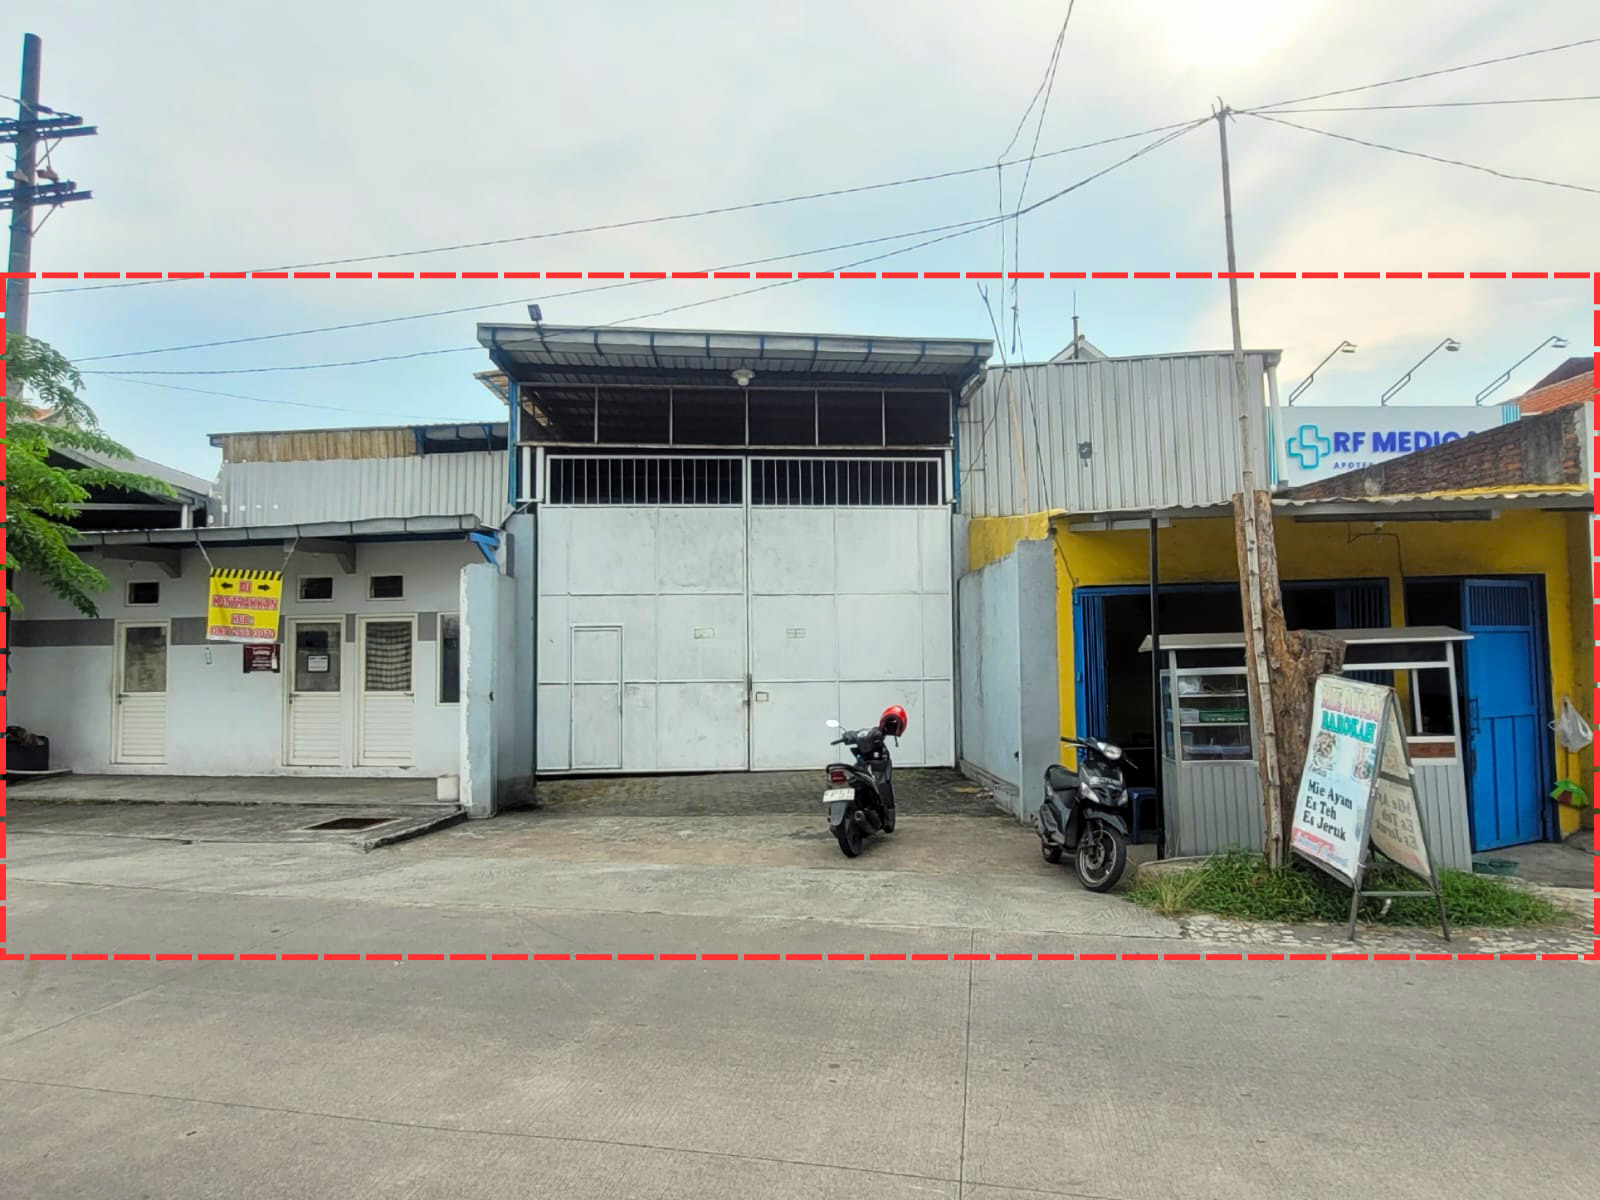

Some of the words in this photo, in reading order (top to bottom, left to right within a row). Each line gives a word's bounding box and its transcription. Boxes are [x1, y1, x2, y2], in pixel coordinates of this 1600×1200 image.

[1333, 431, 1366, 453] RF
[1372, 431, 1477, 453] MEDIC
[1305, 796, 1317, 811] Es
[1319, 801, 1337, 820] Teh
[1308, 779, 1326, 797] Mie
[1327, 787, 1353, 810] Ayam
[1303, 810, 1315, 826] Es
[1317, 817, 1346, 842] Jeruk
